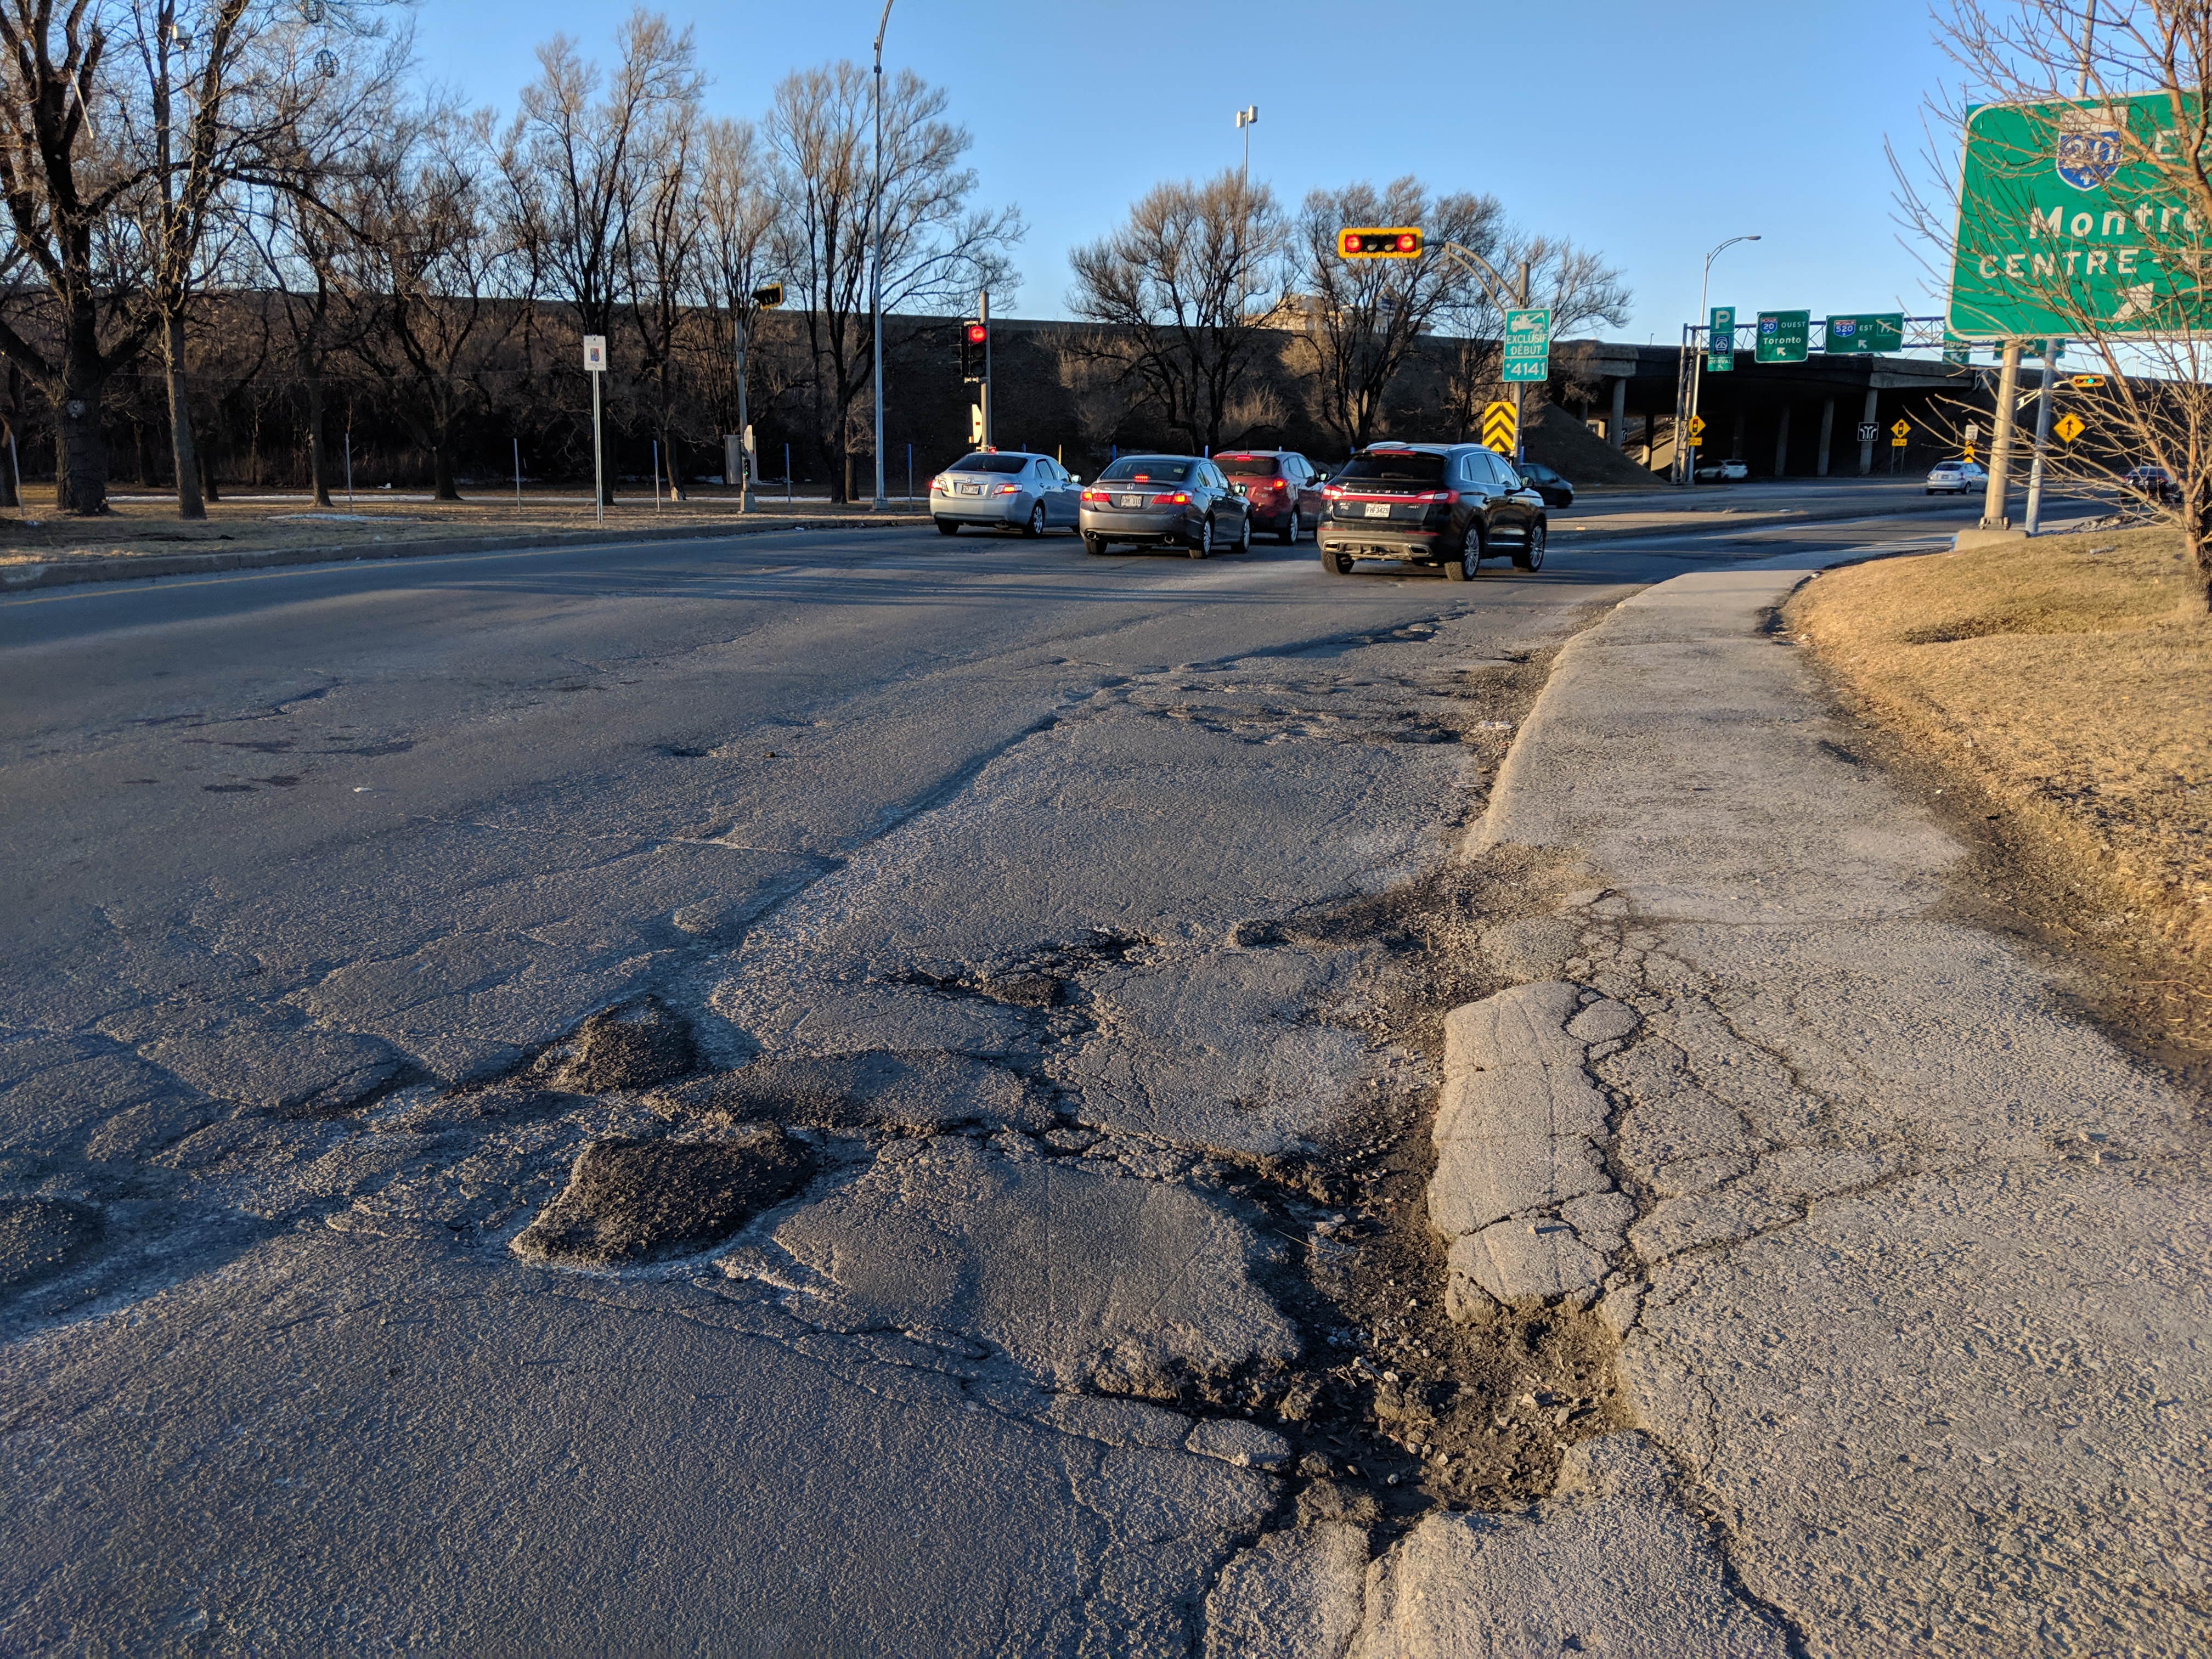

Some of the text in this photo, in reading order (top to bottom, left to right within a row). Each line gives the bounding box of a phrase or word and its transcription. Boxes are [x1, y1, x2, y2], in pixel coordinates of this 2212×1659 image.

[1715, 311, 1730, 329] P
[1506, 333, 1548, 345] EXCLUSIF
[1763, 336, 1802, 345] Toronto
[1510, 343, 1542, 356] DÉBUT
